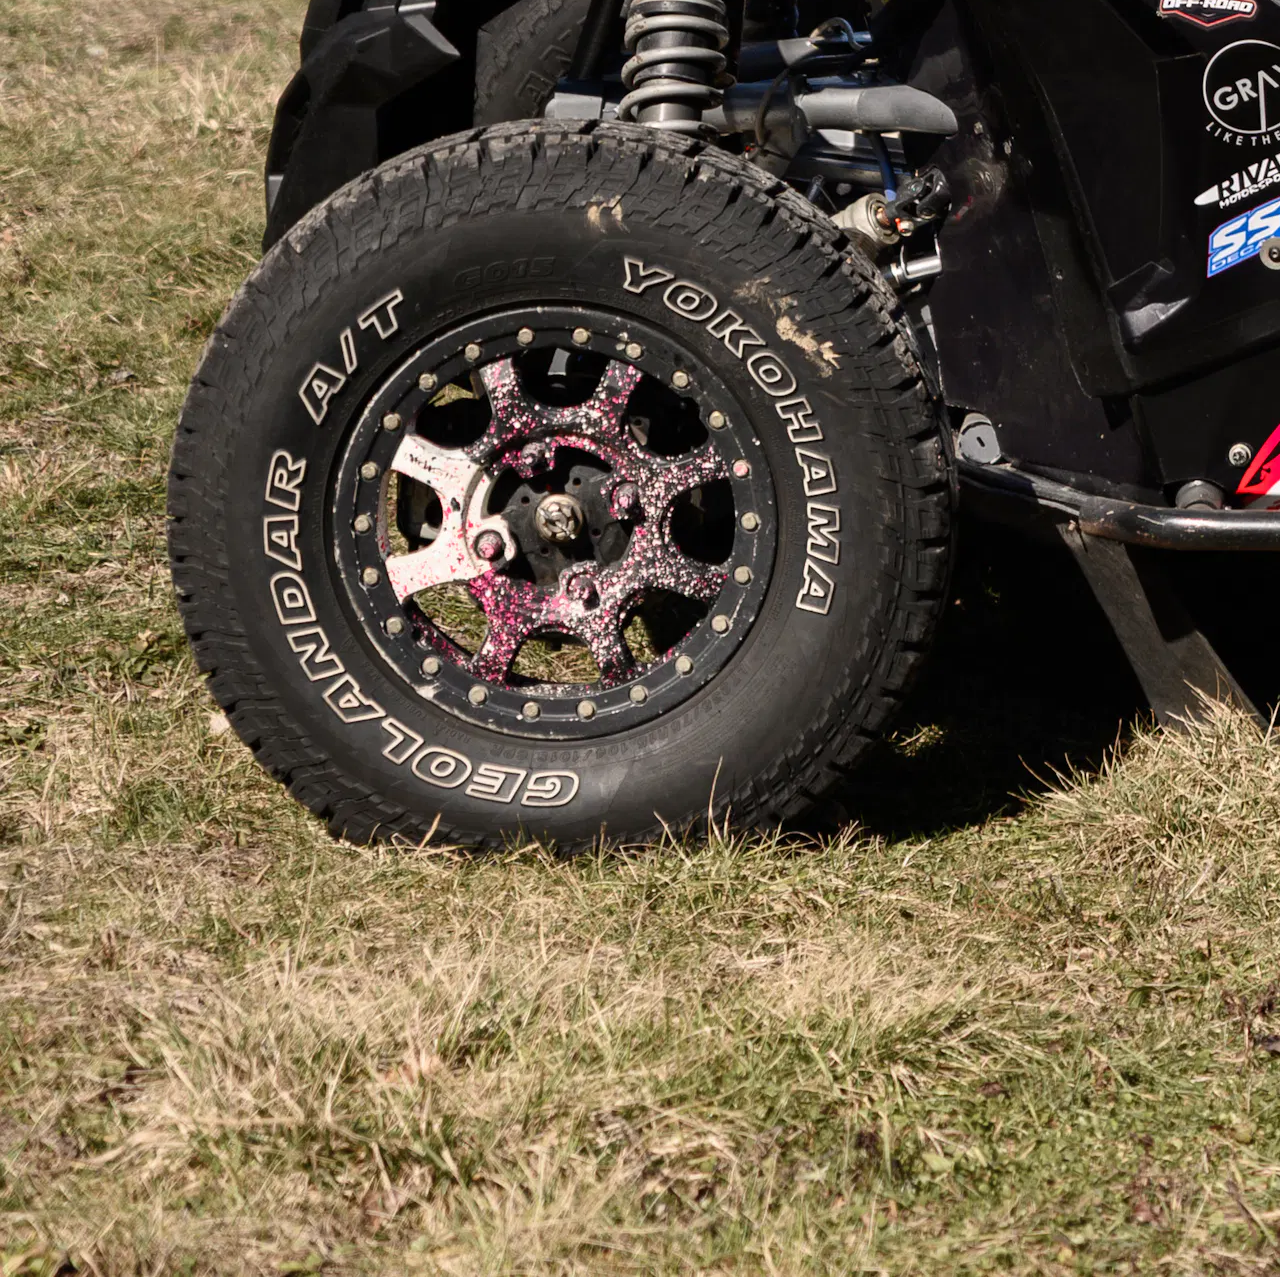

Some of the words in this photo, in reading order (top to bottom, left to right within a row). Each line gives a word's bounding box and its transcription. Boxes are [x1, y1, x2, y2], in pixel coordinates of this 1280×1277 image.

[1205, 121, 1243, 146] LIKE
[298, 289, 406, 425] A/T
[622, 255, 844, 615] YOKOHAMA
[263, 449, 580, 807] GEOLANDAR
